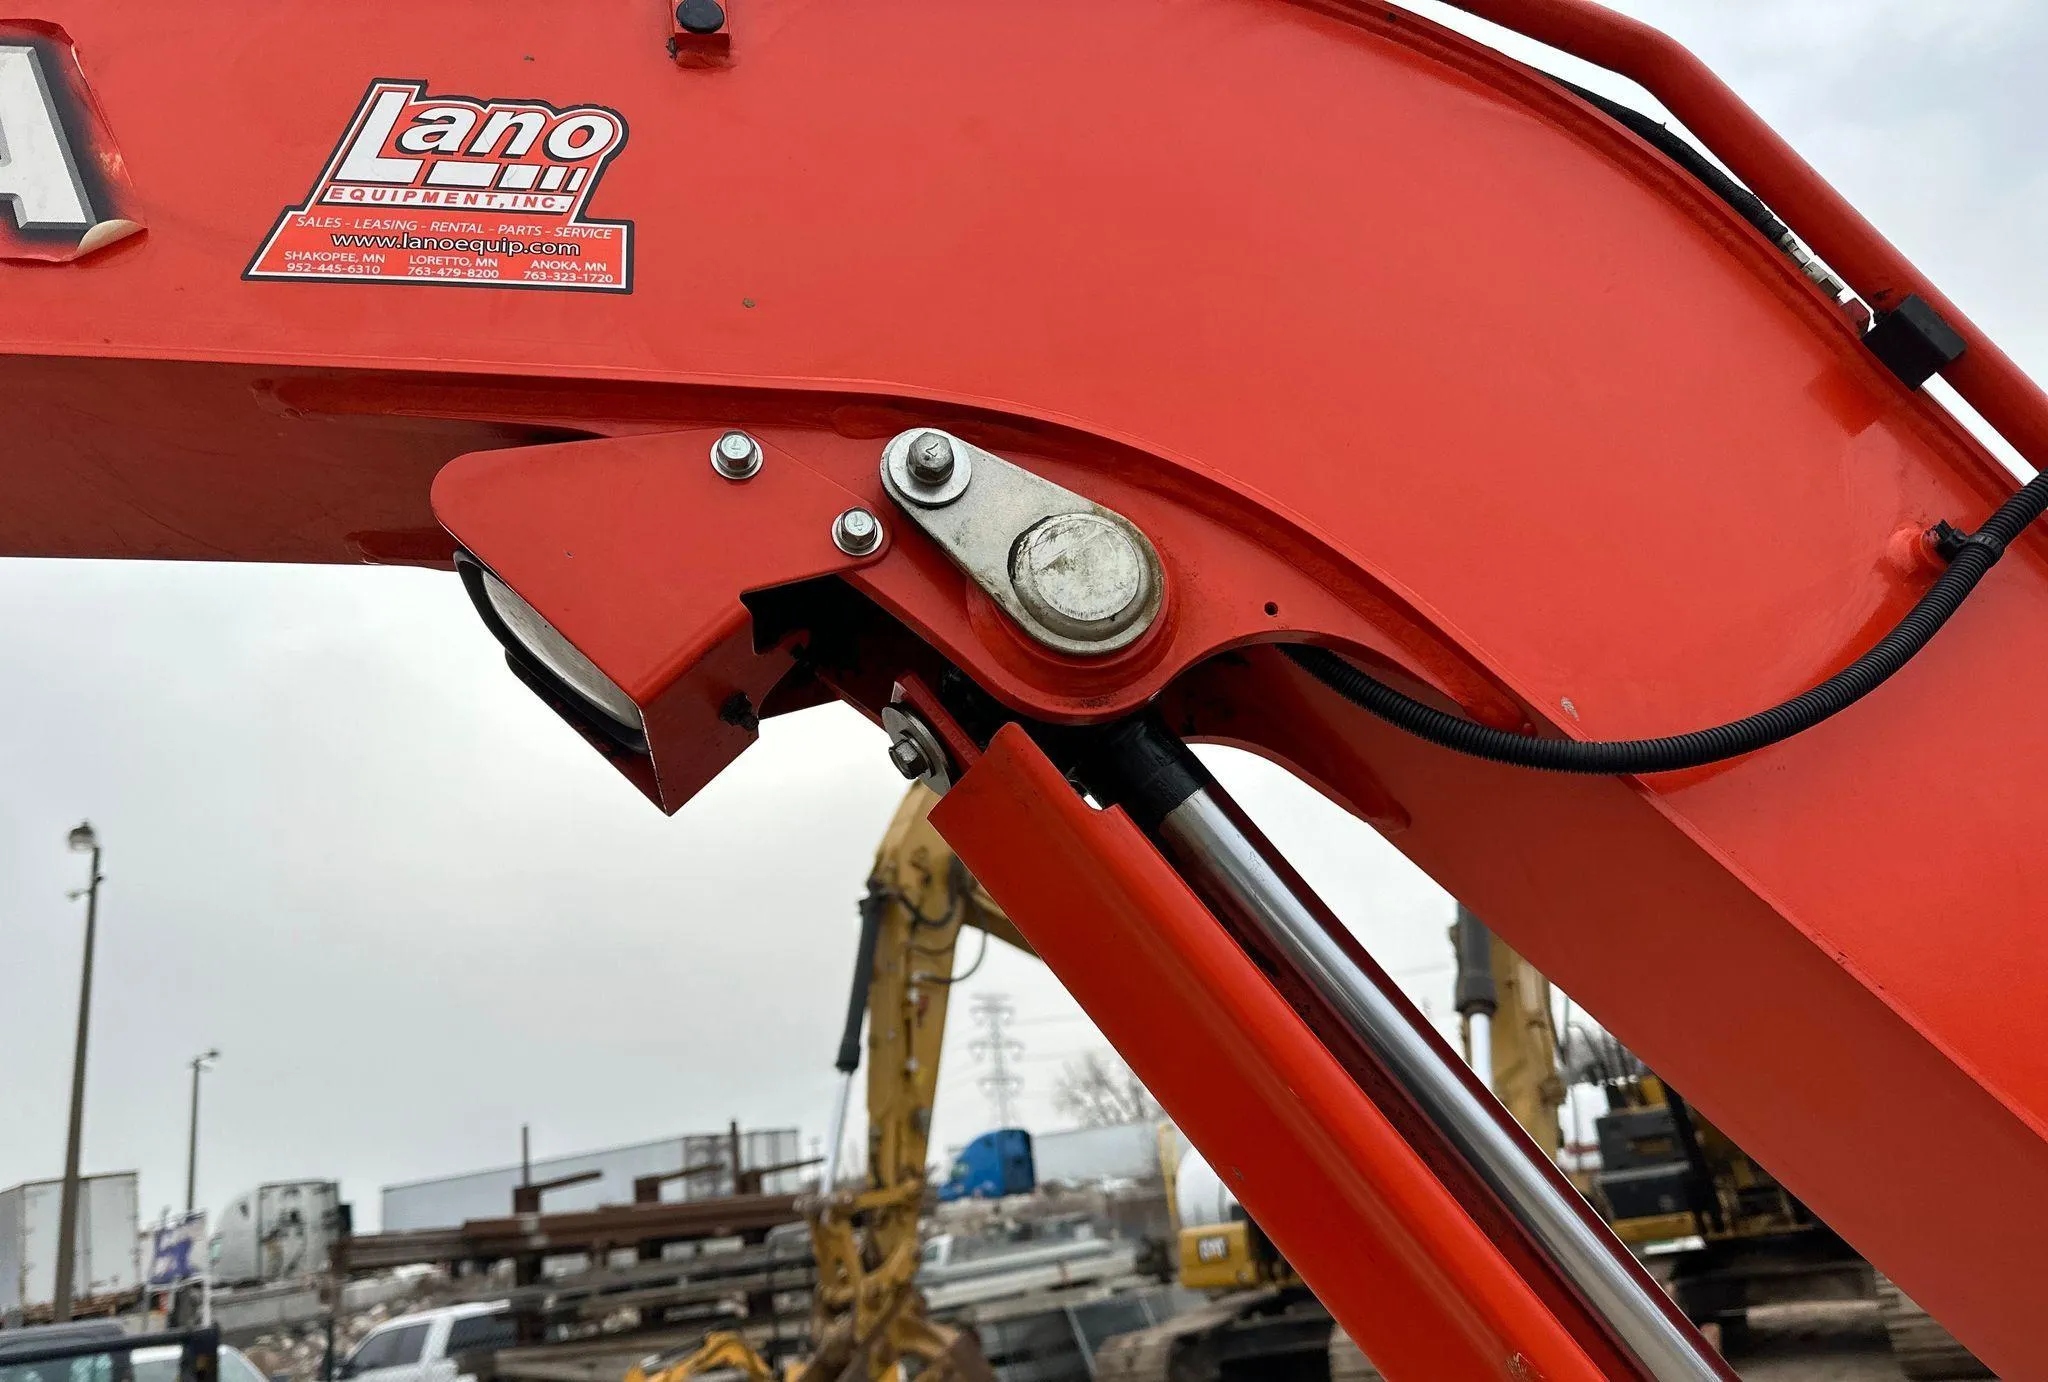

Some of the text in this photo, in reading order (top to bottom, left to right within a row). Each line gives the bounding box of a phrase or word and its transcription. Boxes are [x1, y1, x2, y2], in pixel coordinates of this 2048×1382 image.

[333, 91, 614, 185] Lano
[296, 217, 342, 228] SALES
[354, 219, 417, 231] LEASING
[430, 221, 484, 234] RENTAL
[498, 225, 542, 236] PARTS
[554, 227, 613, 239] SERVICE
[331, 232, 580, 256] www.lanoequip.com
[284, 251, 386, 264] SHAKOPEE, MN
[409, 255, 498, 268] LORETTO, MN
[286, 262, 381, 275] 952-445-6310
[407, 266, 499, 279] 763-479-8200
[530, 260, 607, 272] ANOKA, MN
[523, 271, 614, 283] 763-323-1720
